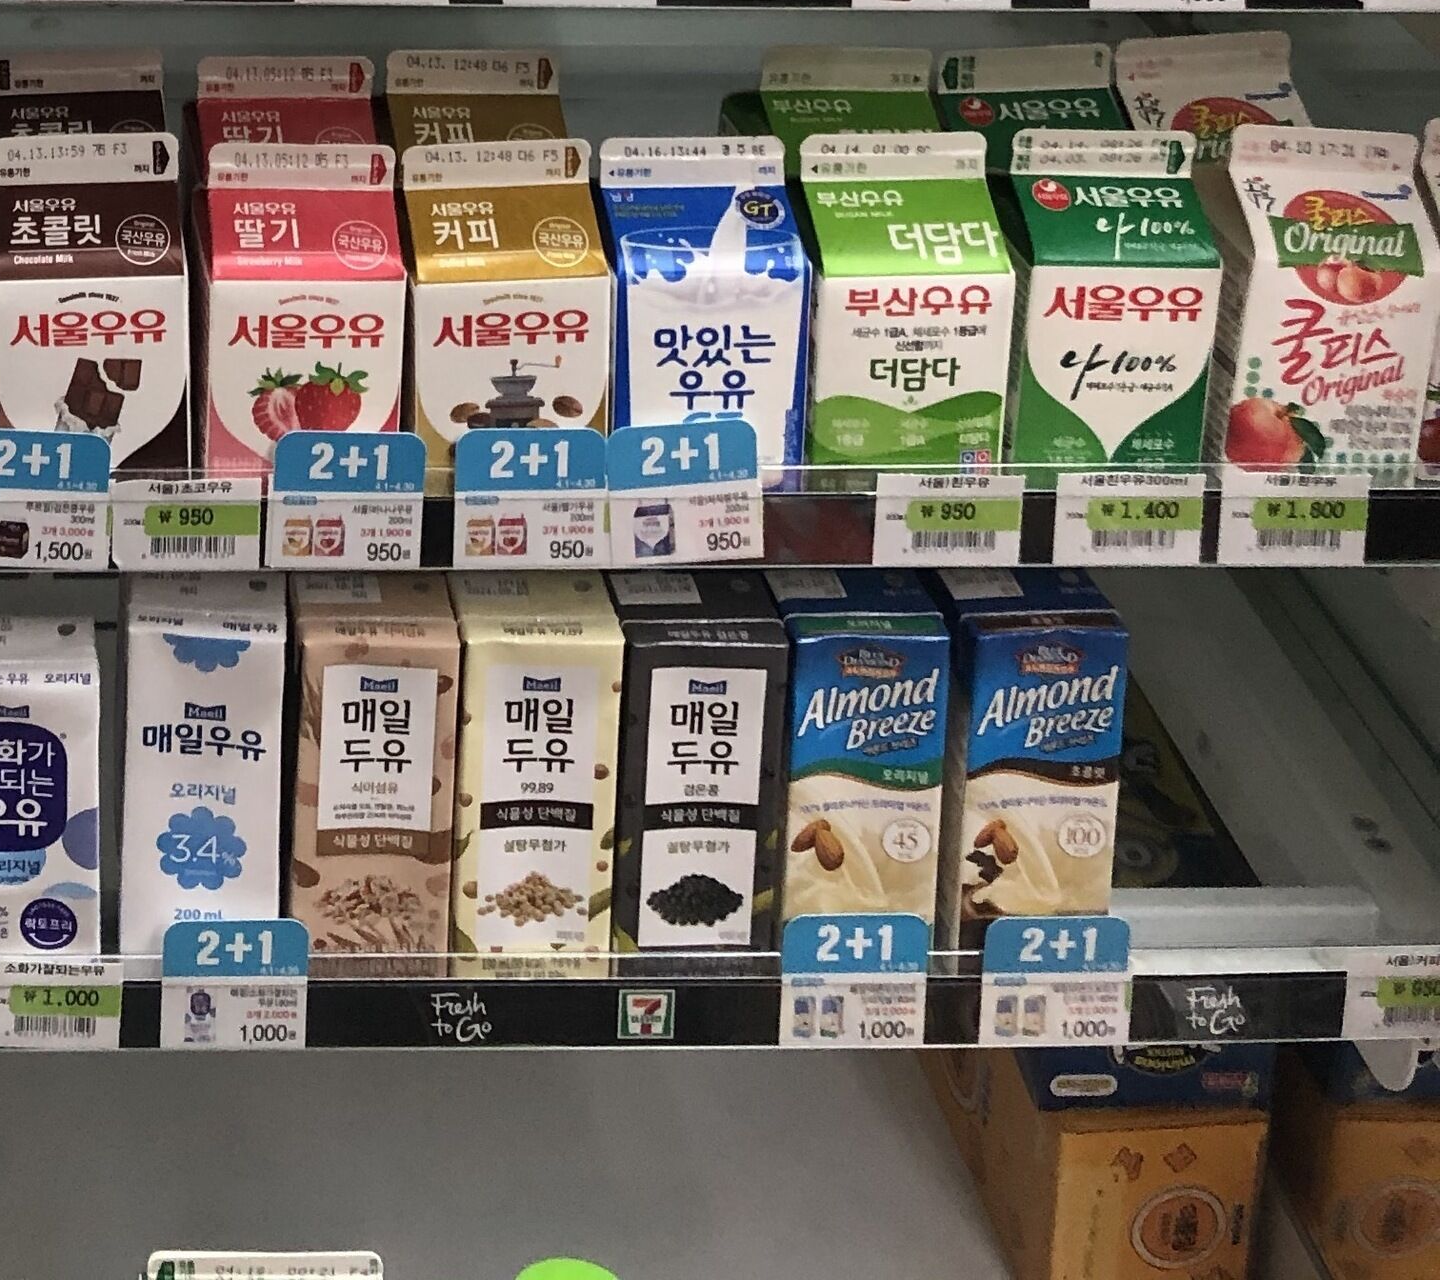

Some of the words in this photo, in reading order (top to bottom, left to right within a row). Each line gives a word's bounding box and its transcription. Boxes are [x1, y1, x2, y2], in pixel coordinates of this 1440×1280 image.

[10, 215, 103, 247] 초콜릿
[234, 217, 301, 251] 딸기
[432, 218, 500, 251] 커피
[887, 221, 1000, 266] 더담다
[1284, 226, 1406, 261] Original
[845, 286, 993, 317] 부산우유
[1043, 284, 1204, 323] 서울우유
[653, 324, 776, 368] 맛있는
[669, 369, 755, 411] 우유
[179, 506, 214, 527] 950
[504, 697, 575, 735] 매일
[797, 667, 940, 737] Almond
[142, 722, 267, 762] 매일우유
[847, 709, 937, 750] Breeze
[502, 738, 576, 775] 두유
[197, 930, 274, 966] 2+1
